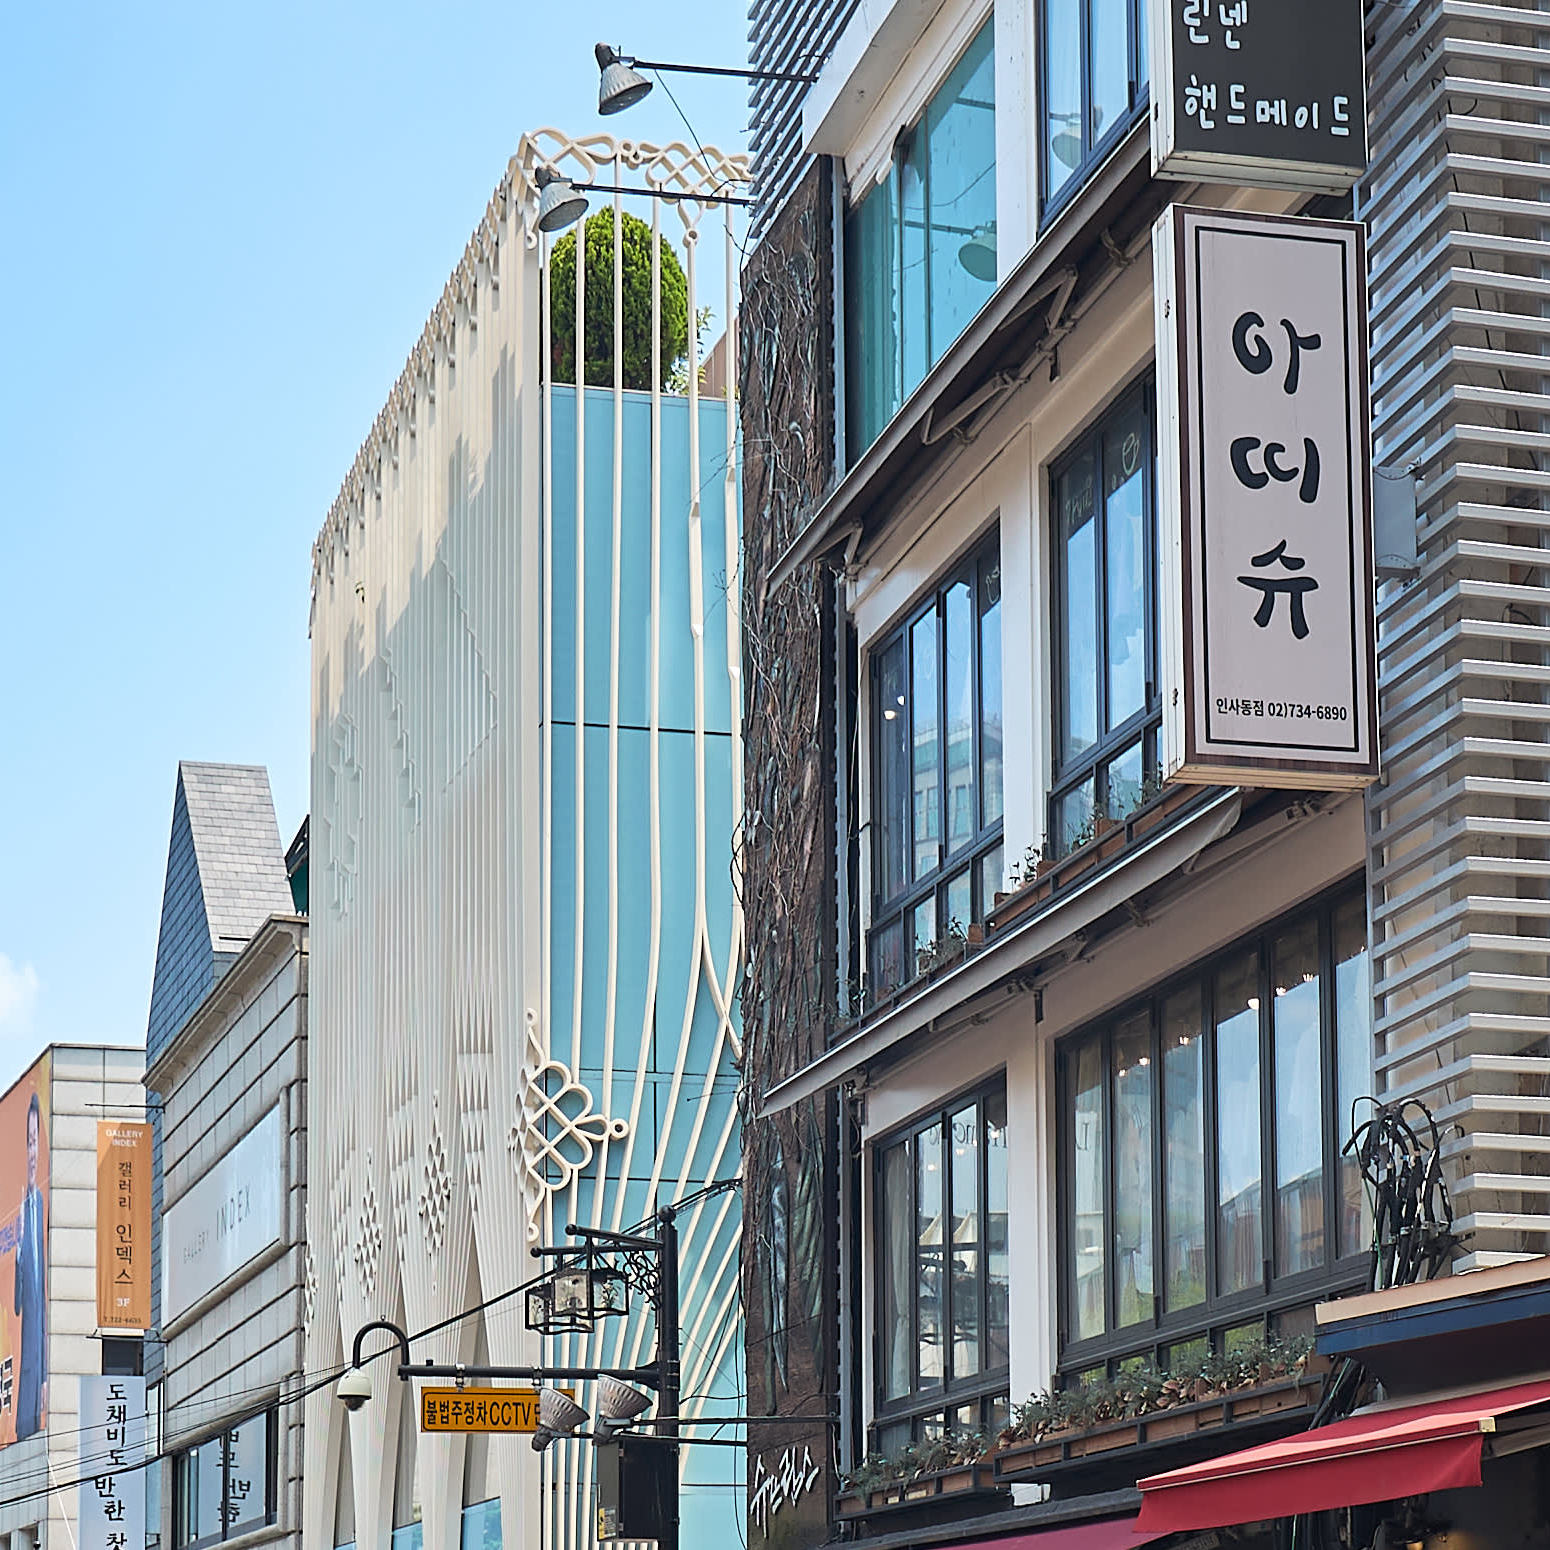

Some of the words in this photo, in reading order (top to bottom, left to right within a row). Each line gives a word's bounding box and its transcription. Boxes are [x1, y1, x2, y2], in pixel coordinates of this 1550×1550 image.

[1184, 74, 1351, 138] 핸드메이드
[1230, 310, 1322, 641] 아띠슈
[1216, 695, 1265, 718] 인사동점
[1268, 702, 1348, 723] 02)734-6890
[106, 1130, 143, 1138] GALLERY
[113, 1139, 137, 1148] INDEX
[118, 1161, 132, 1211] 갤러리
[216, 1184, 251, 1241] INDEX
[114, 1223, 133, 1285] 인덱스
[116, 1298, 130, 1307] 3F
[106, 1384, 128, 1466] 도채비도
[426, 1400, 531, 1426] 불법주정차CCTV
[94, 1476, 127, 1522] 반한
